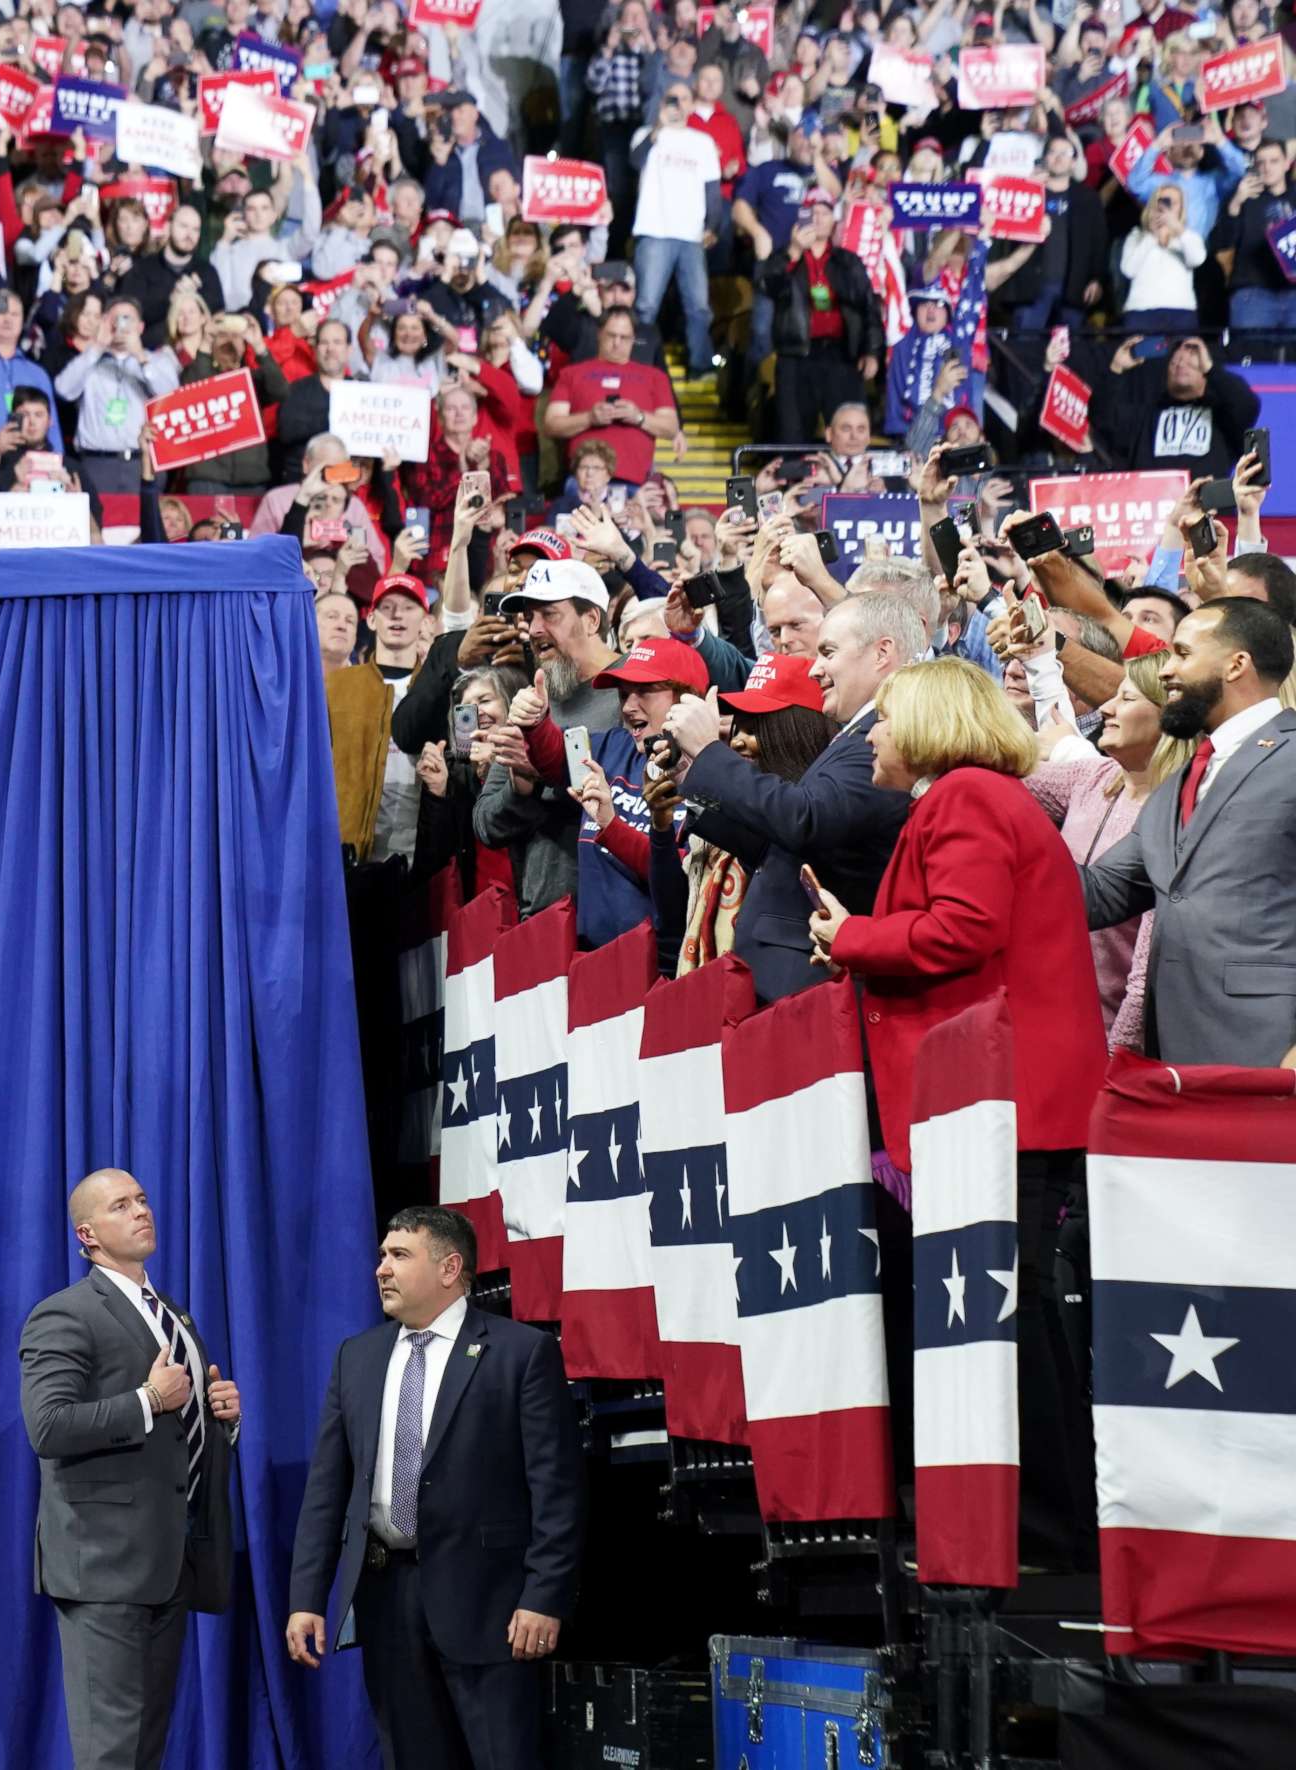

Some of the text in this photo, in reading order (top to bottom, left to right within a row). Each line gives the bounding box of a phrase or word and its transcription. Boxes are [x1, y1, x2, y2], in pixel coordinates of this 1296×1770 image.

[1206, 51, 1276, 83] TRUMP
[532, 175, 603, 194] TRUMP
[894, 190, 977, 205] TRUMP
[984, 187, 1042, 208] RUMP
[152, 390, 247, 432] TRUMP
[361, 397, 403, 409] KEEP
[338, 411, 423, 431] AMERICA
[5, 506, 55, 521] KEEP
